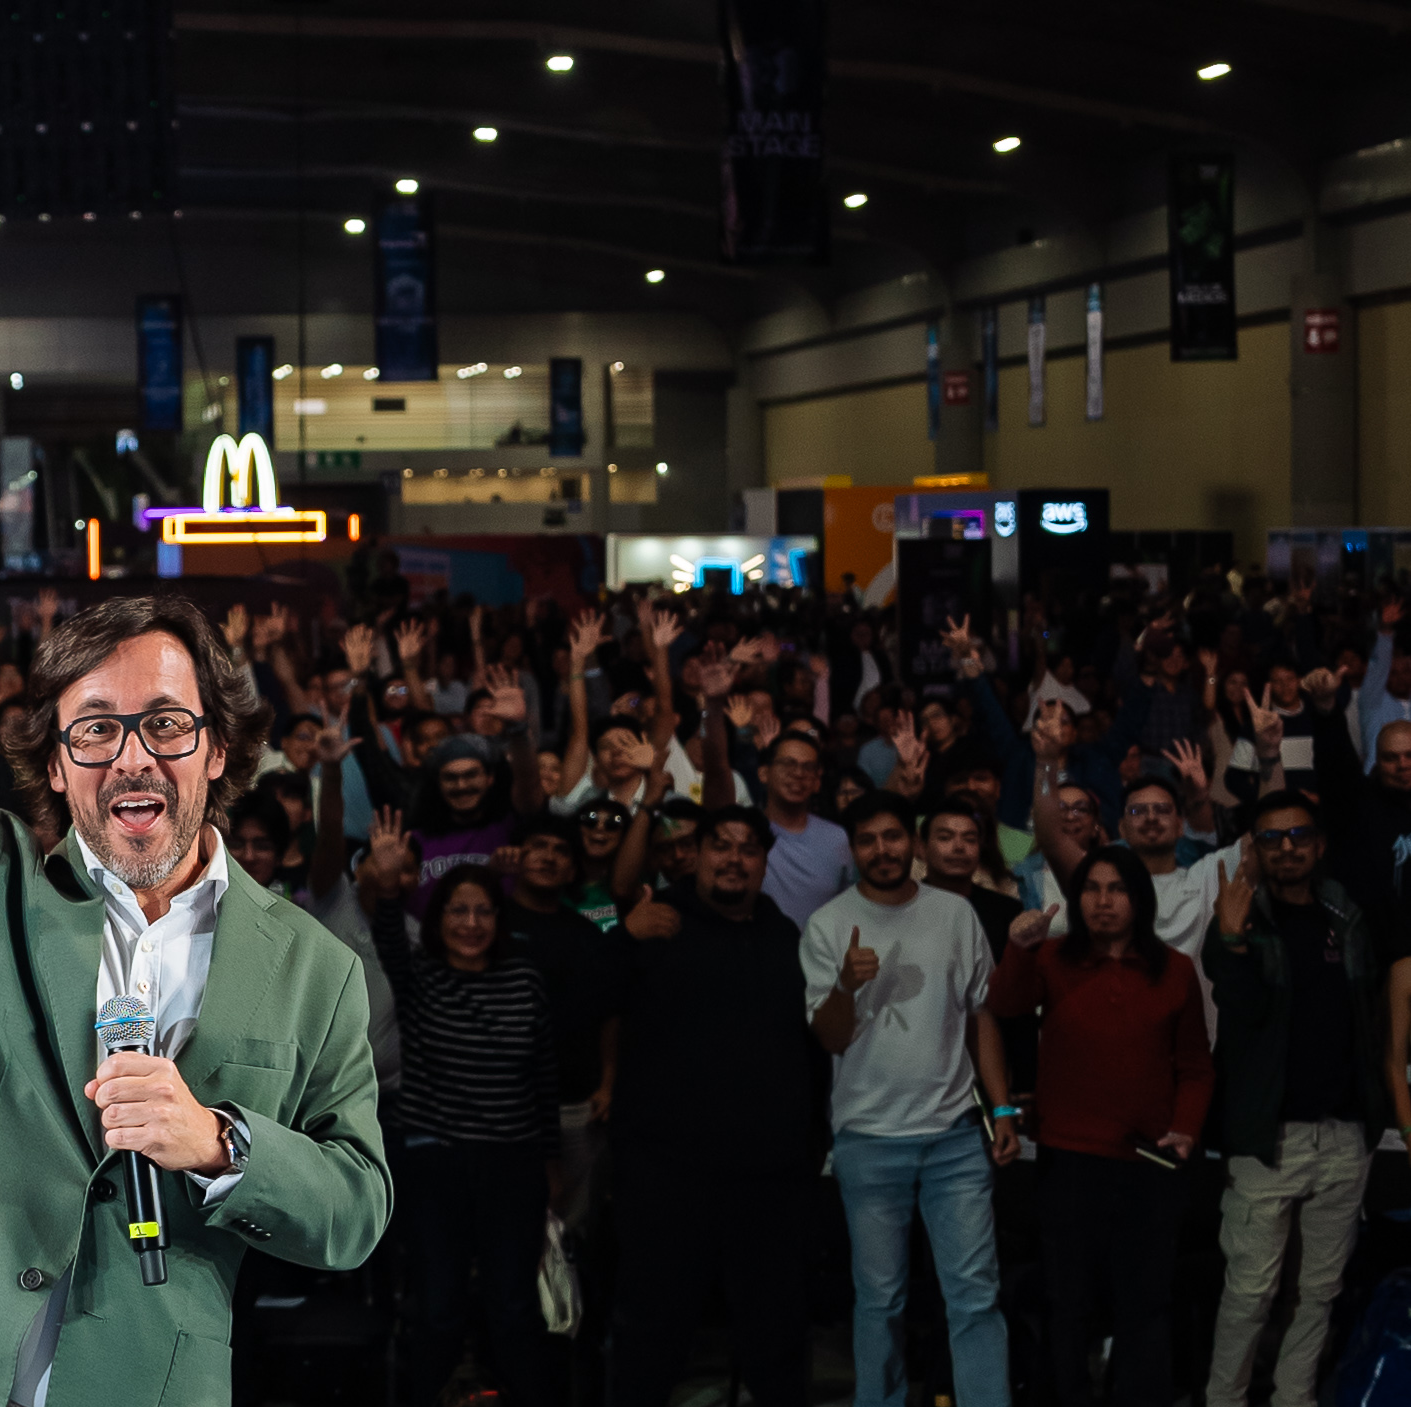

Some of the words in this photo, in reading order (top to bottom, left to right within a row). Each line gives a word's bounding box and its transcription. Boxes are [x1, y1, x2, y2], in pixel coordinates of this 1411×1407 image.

[737, 110, 812, 134] MAIN
[727, 133, 820, 160] STAGE
[1041, 502, 1087, 522] aws
